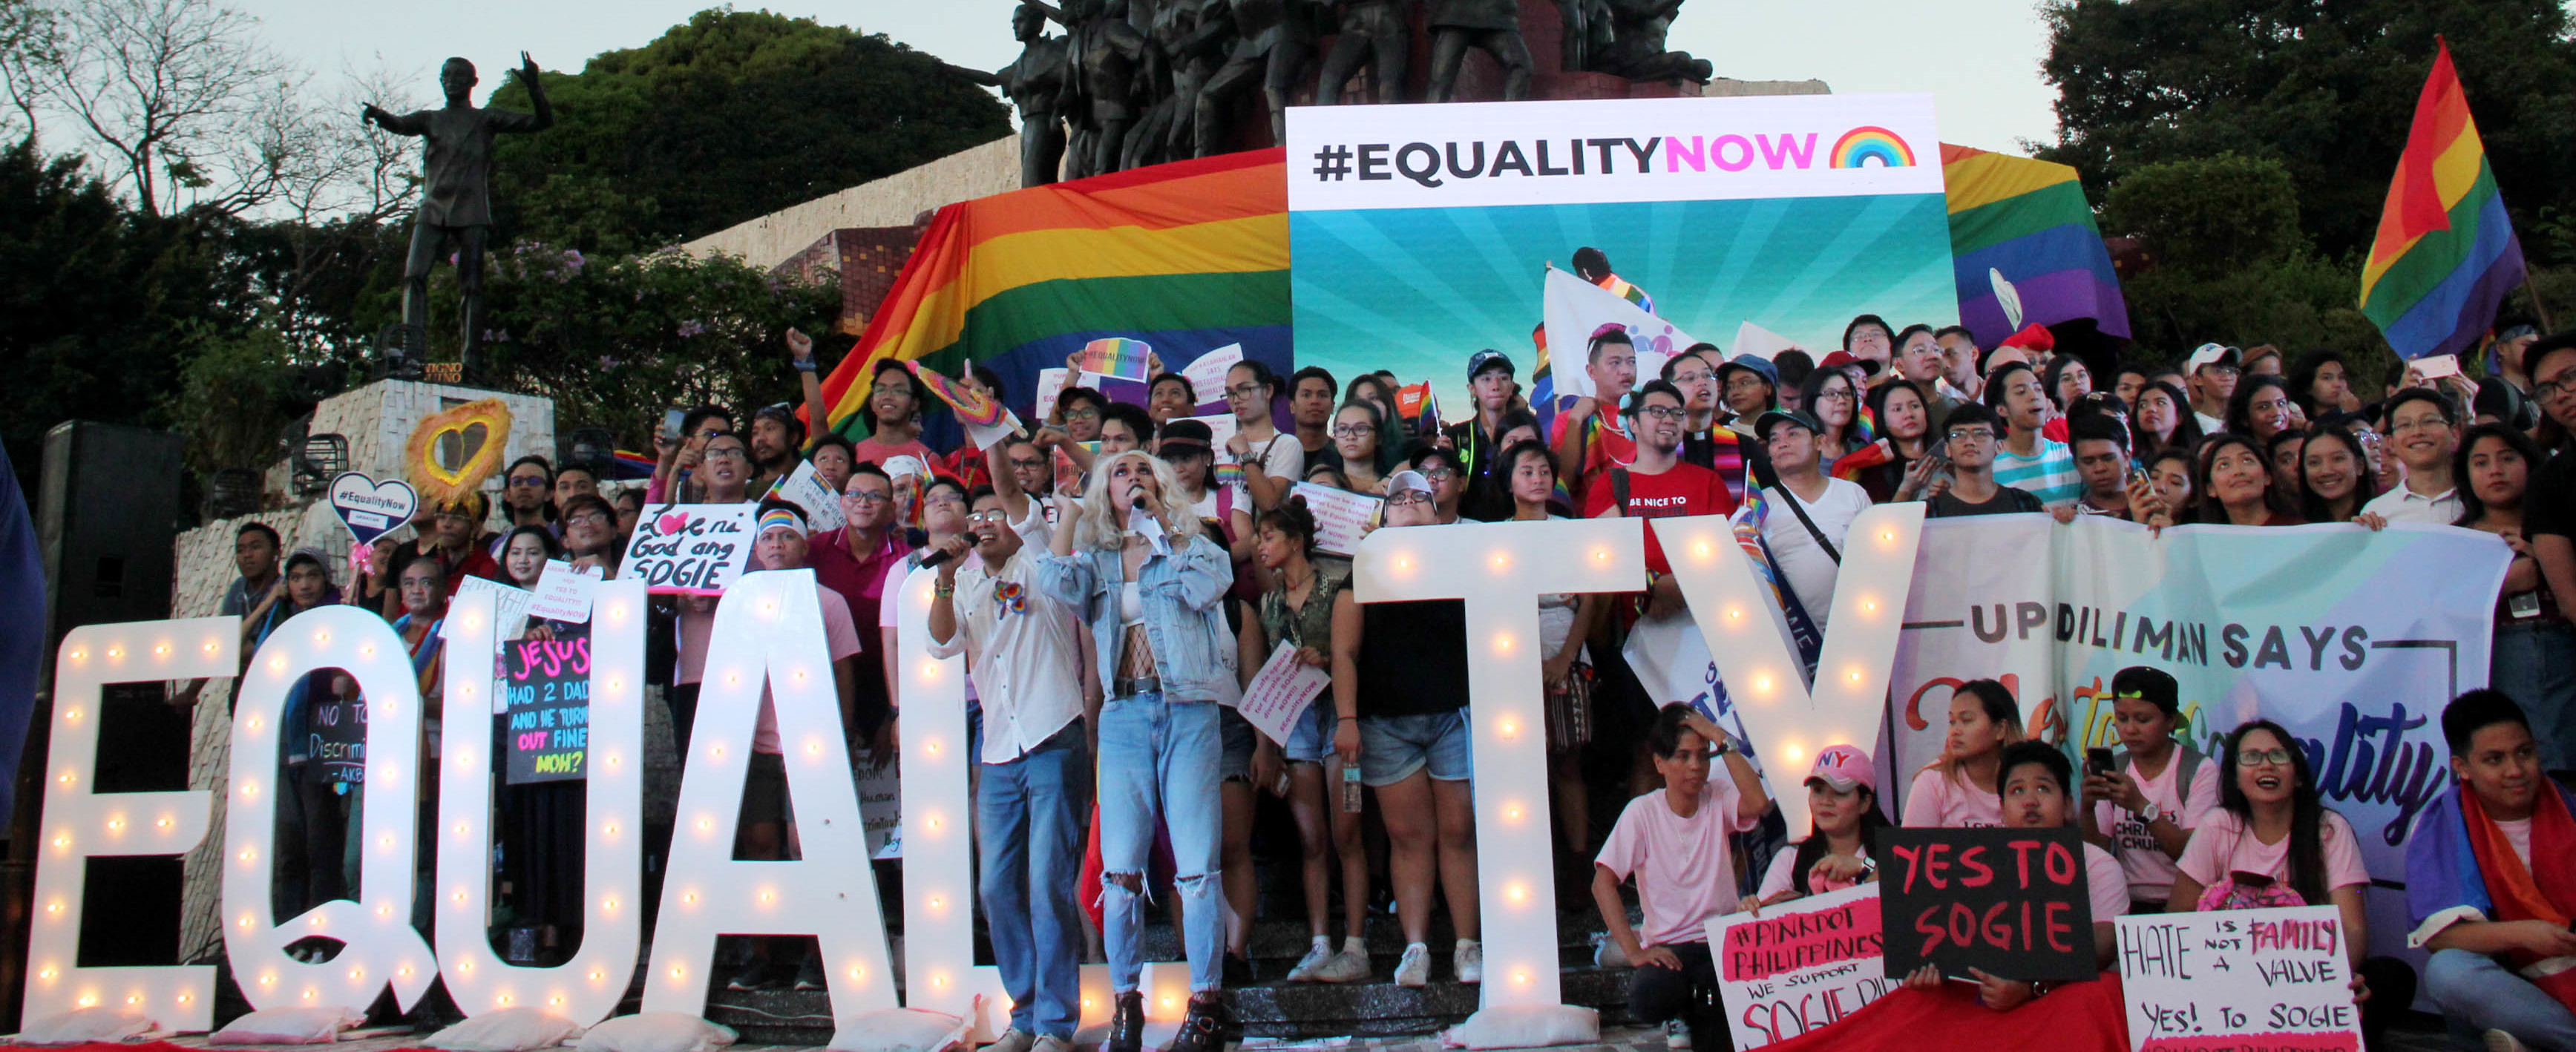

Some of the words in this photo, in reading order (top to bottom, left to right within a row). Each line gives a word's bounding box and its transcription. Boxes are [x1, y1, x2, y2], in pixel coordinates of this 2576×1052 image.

[1313, 133, 1818, 188] #EQUALITYNOW
[339, 490, 406, 510] #EqualityNow
[1629, 497, 1641, 506] BE
[1644, 497, 1669, 507] NICE
[1671, 496, 1686, 504] TO
[630, 534, 685, 559] God
[690, 541, 735, 561] ang
[634, 558, 730, 590] SOGIE
[1971, 602, 2047, 643] UP
[2056, 602, 2208, 667] DILIMAN
[2222, 624, 2370, 671] SAYS
[514, 637, 590, 680] JESUS
[508, 685, 535, 705] HAD
[543, 681, 557, 702] 2
[563, 680, 589, 700] DAD
[1279, 679, 1317, 732] #EqualityNOW
[318, 705, 339, 726] NO
[511, 711, 537, 730] AND
[558, 705, 589, 726] TURN
[310, 733, 366, 759] Discrimi
[517, 730, 548, 752] OUT
[553, 727, 588, 749] FINE
[332, 766, 364, 783] -AKB
[1816, 750, 1851, 769] NY
[1892, 844, 1994, 895] YES
[2007, 840, 2077, 890] TO
[1734, 907, 1855, 947] #PINKDOT
[1915, 900, 2073, 957] SOGIE
[1734, 933, 1884, 979] PHILIPPINES
[2121, 923, 2192, 981] HATE
[2215, 920, 2238, 933] IS
[2246, 918, 2337, 957] FAMILY
[2205, 938, 2241, 950] NOT
[1747, 983, 1775, 999] WE
[1785, 963, 1859, 987] SUPPORT
[2212, 956, 2229, 973] A
[2256, 959, 2337, 987] VALUE
[2141, 1002, 2203, 1038] YES!
[2268, 1002, 2352, 1029] SOGIE
